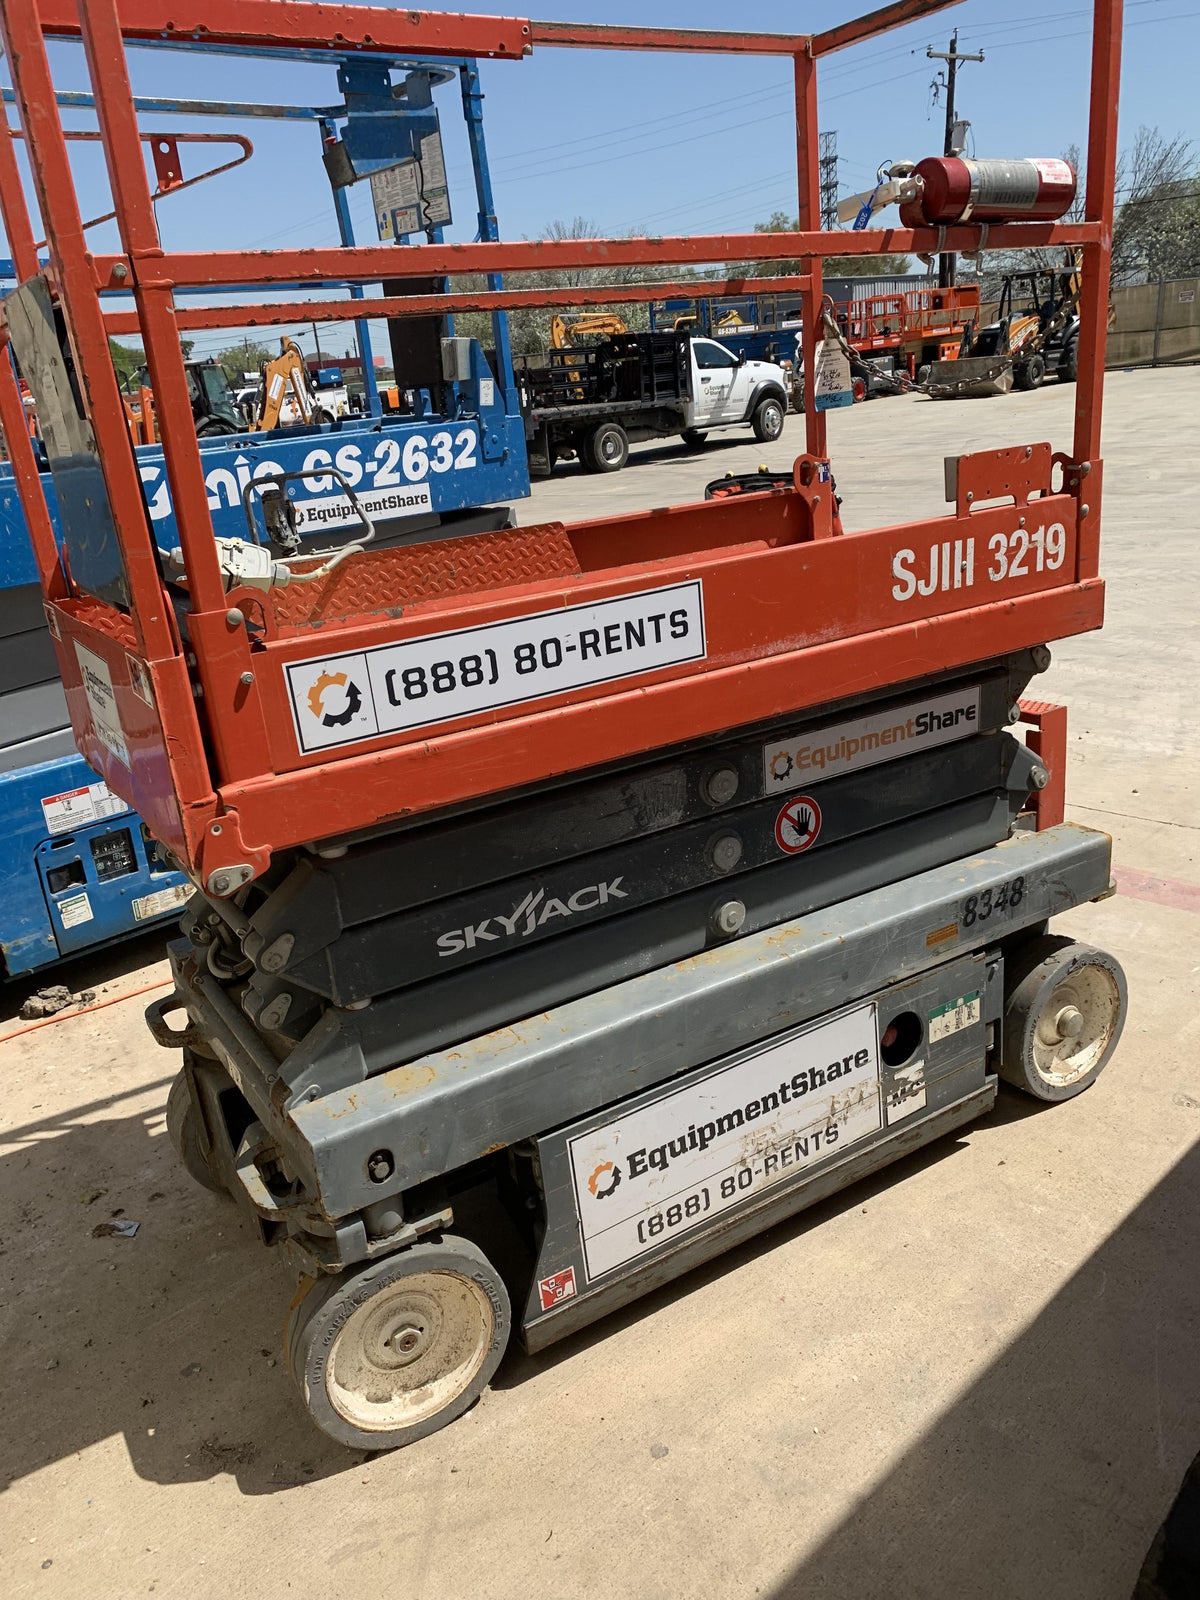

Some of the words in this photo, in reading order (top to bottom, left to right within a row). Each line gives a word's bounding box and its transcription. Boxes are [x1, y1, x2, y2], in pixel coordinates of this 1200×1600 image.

[138, 454, 286, 521] Gnie
[302, 428, 477, 493] GS-2632
[306, 493, 429, 522] EquipmentShare
[988, 522, 1066, 582] 3219
[385, 648, 499, 707] (888)
[514, 608, 690, 676] 80-RENTS
[795, 704, 977, 769] EquipmentShare
[436, 875, 629, 957] SKYJACK
[963, 876, 1025, 928] 8348
[626, 1048, 869, 1180] EquipmentShare
[637, 1187, 710, 1244] (888)
[720, 1123, 839, 1200] 80-RENTS
